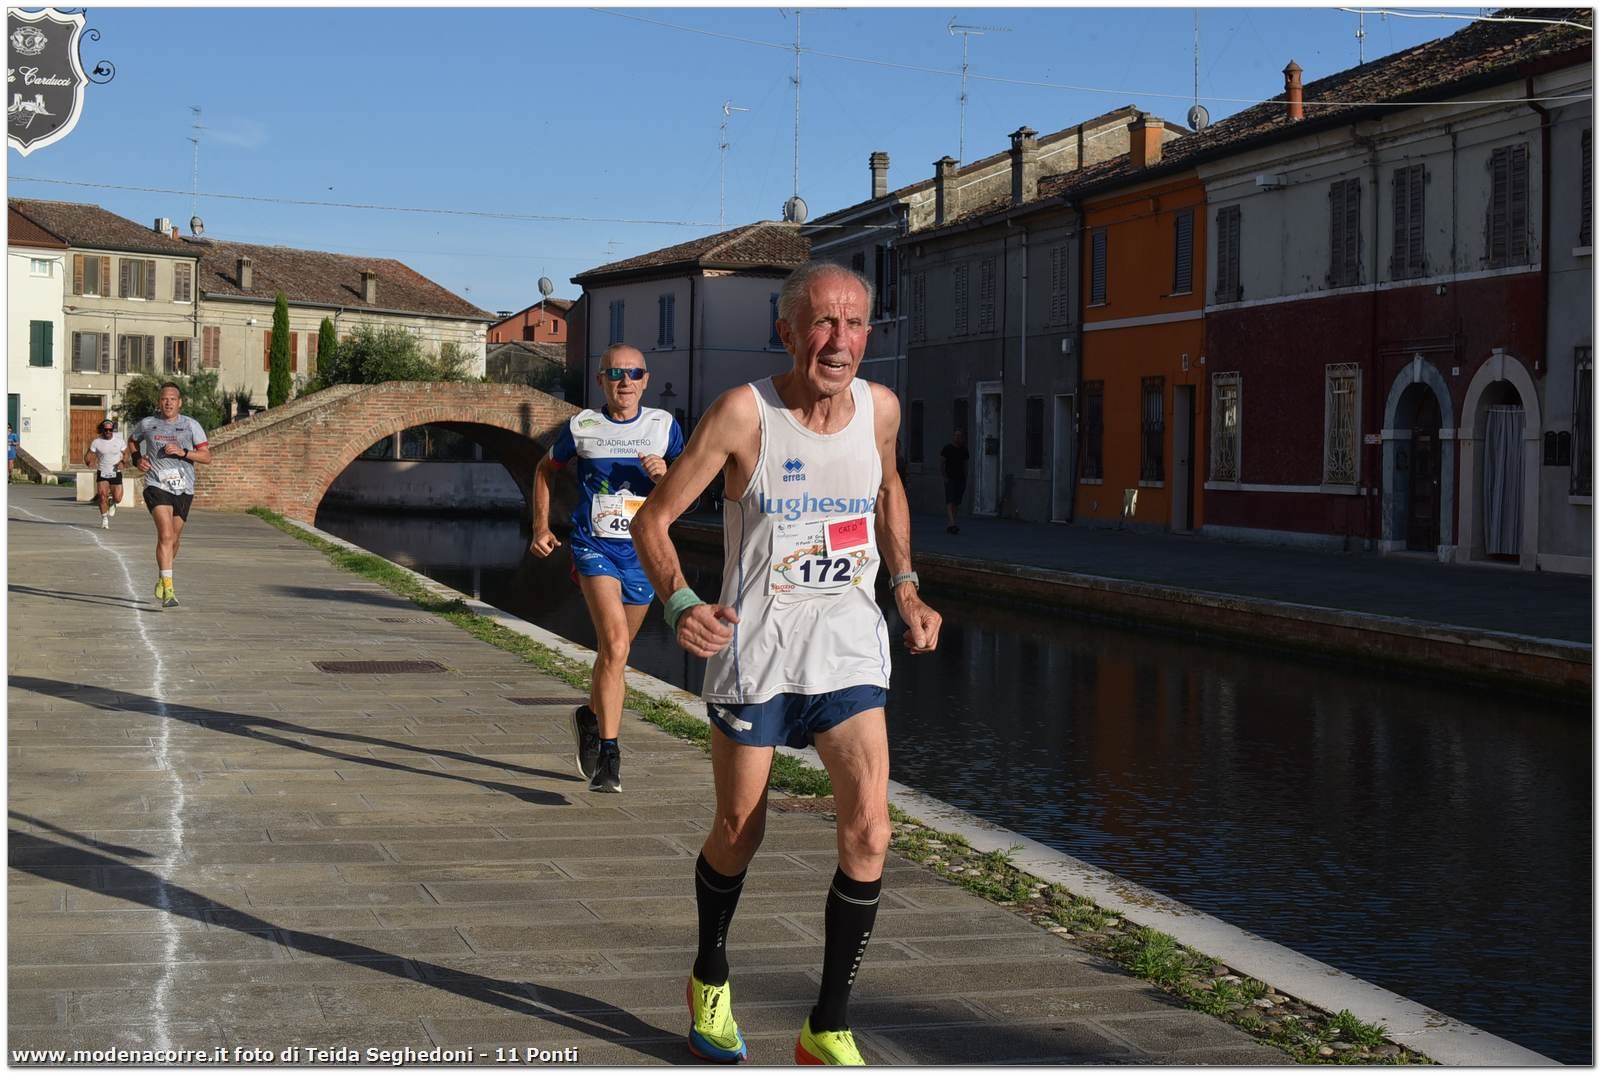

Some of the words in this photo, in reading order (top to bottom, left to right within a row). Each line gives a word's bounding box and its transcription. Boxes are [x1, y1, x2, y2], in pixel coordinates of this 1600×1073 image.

[18, 66, 72, 86] Carducci
[596, 438, 651, 447] QUADRILATERO
[609, 517, 630, 532] 49
[800, 558, 851, 582] 172
[847, 931, 870, 985] OXYBURN
